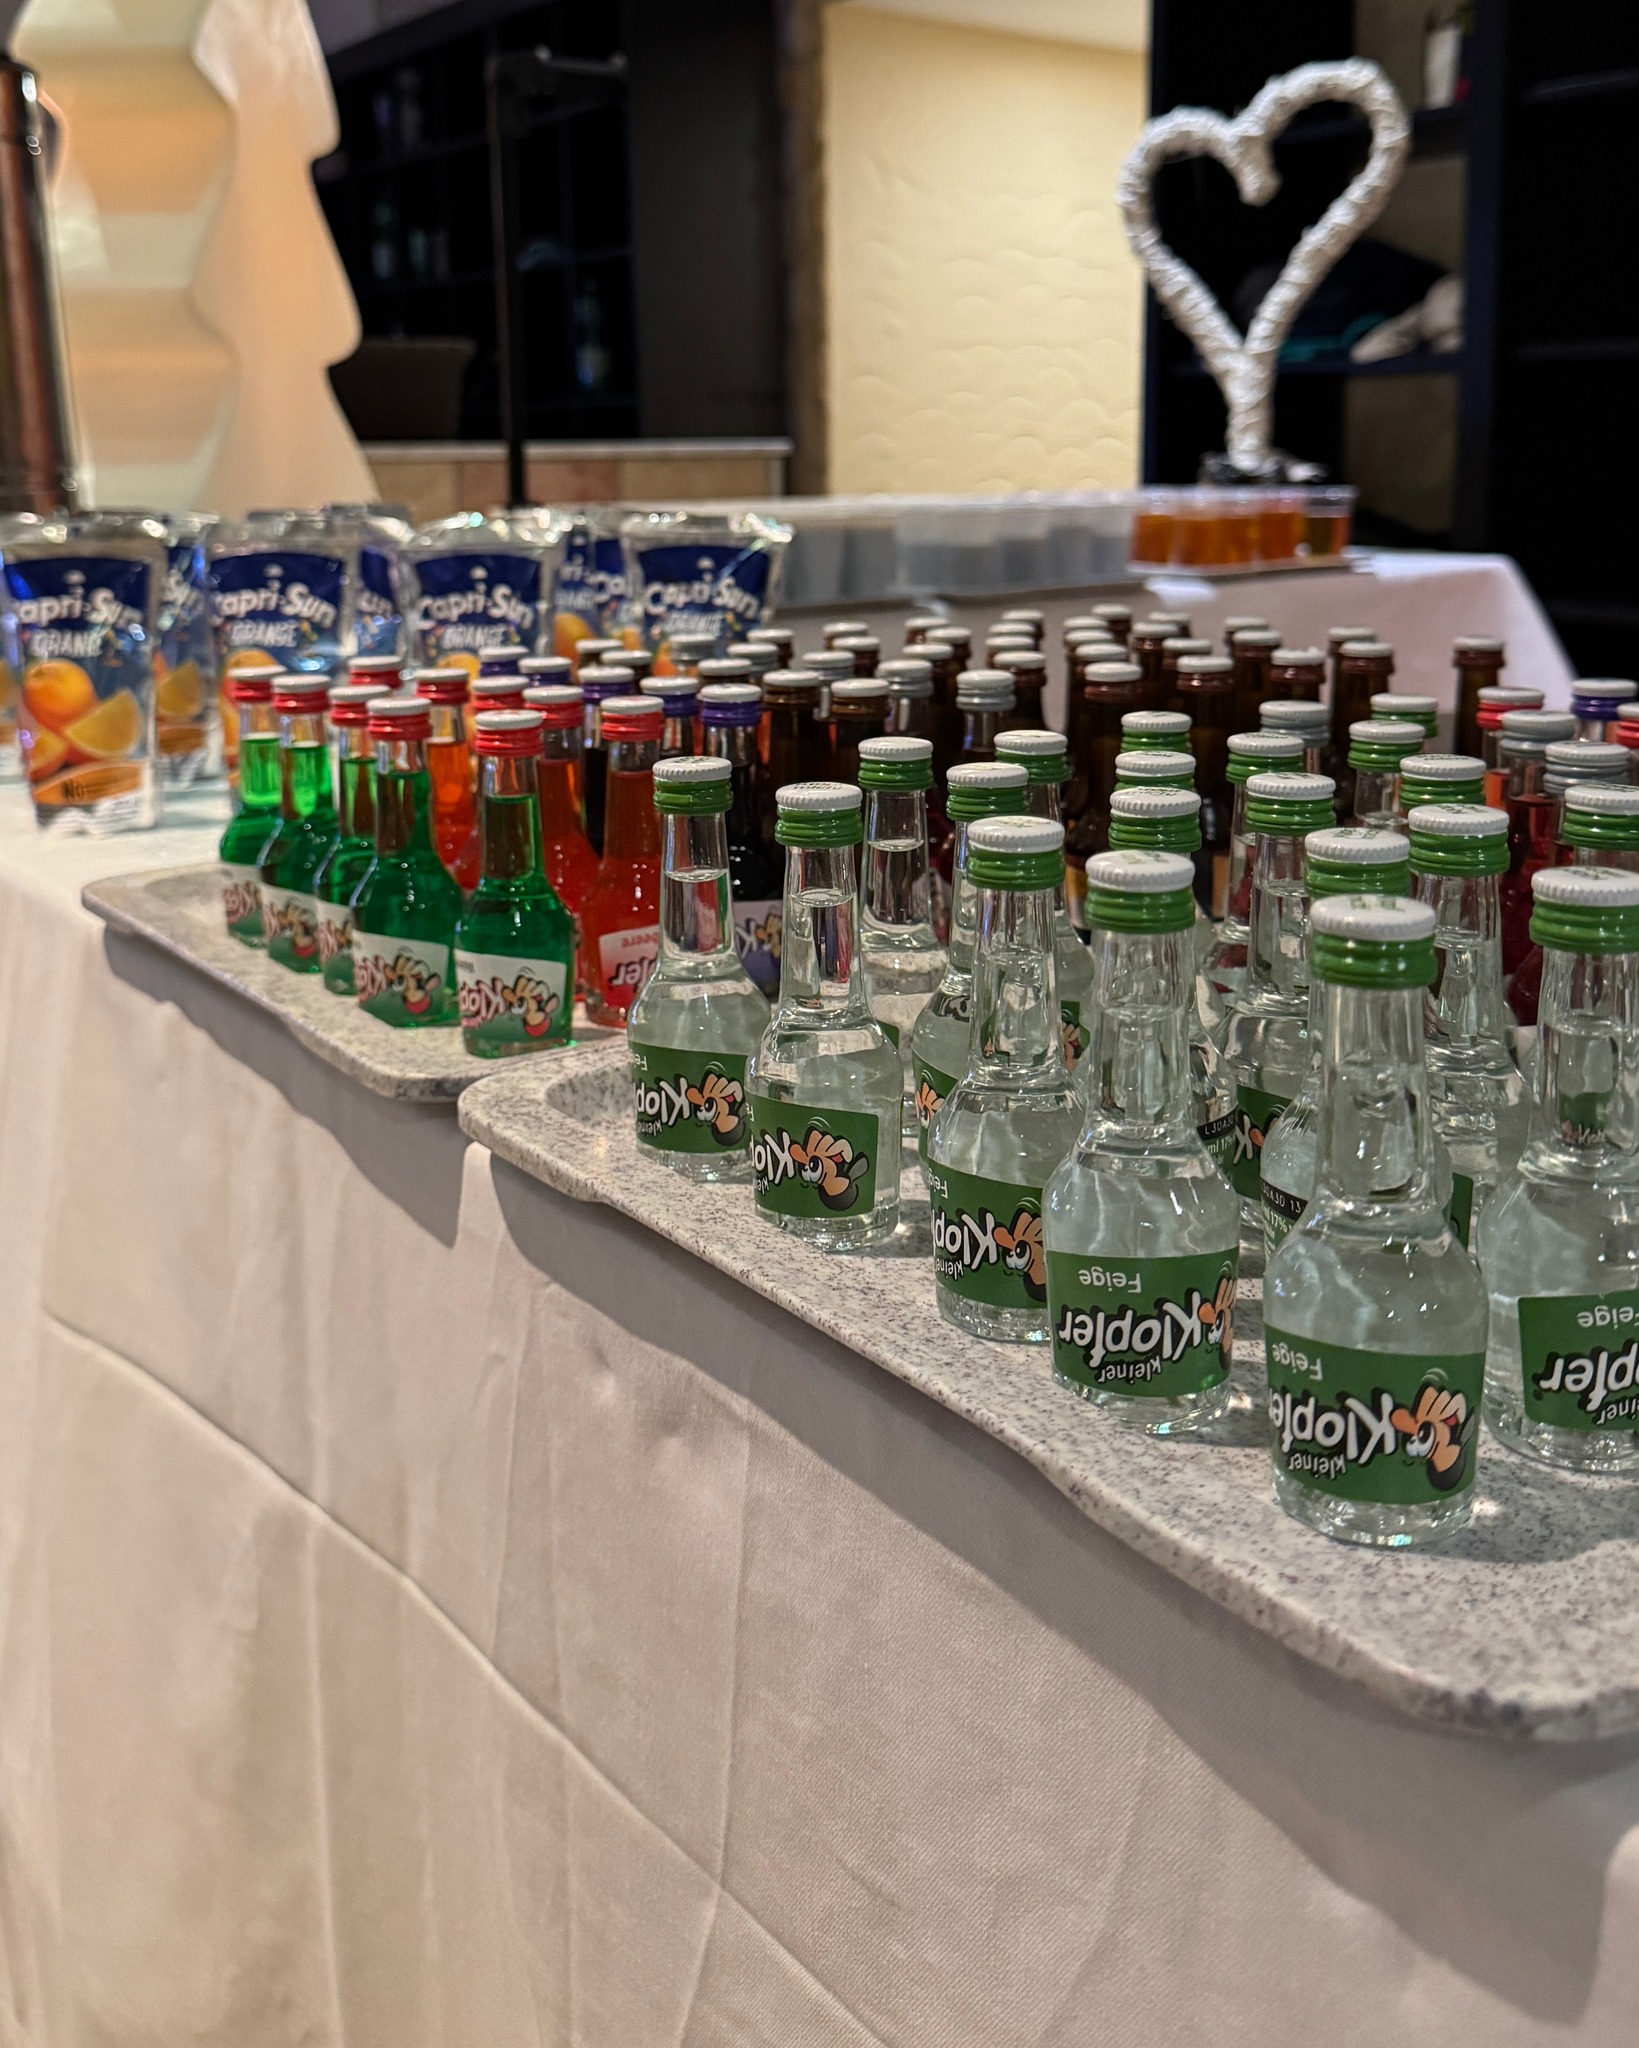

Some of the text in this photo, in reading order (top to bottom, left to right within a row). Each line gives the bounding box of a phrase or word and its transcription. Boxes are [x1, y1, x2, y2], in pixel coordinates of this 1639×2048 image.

[1077, 1265, 1142, 1294] Feige
[1058, 1290, 1202, 1368] Klopfer
[1097, 1355, 1162, 1384] kleiner
[1271, 1341, 1323, 1381] Feige
[1539, 1341, 1639, 1413] pfer
[1287, 1452, 1347, 1481] kleiner
